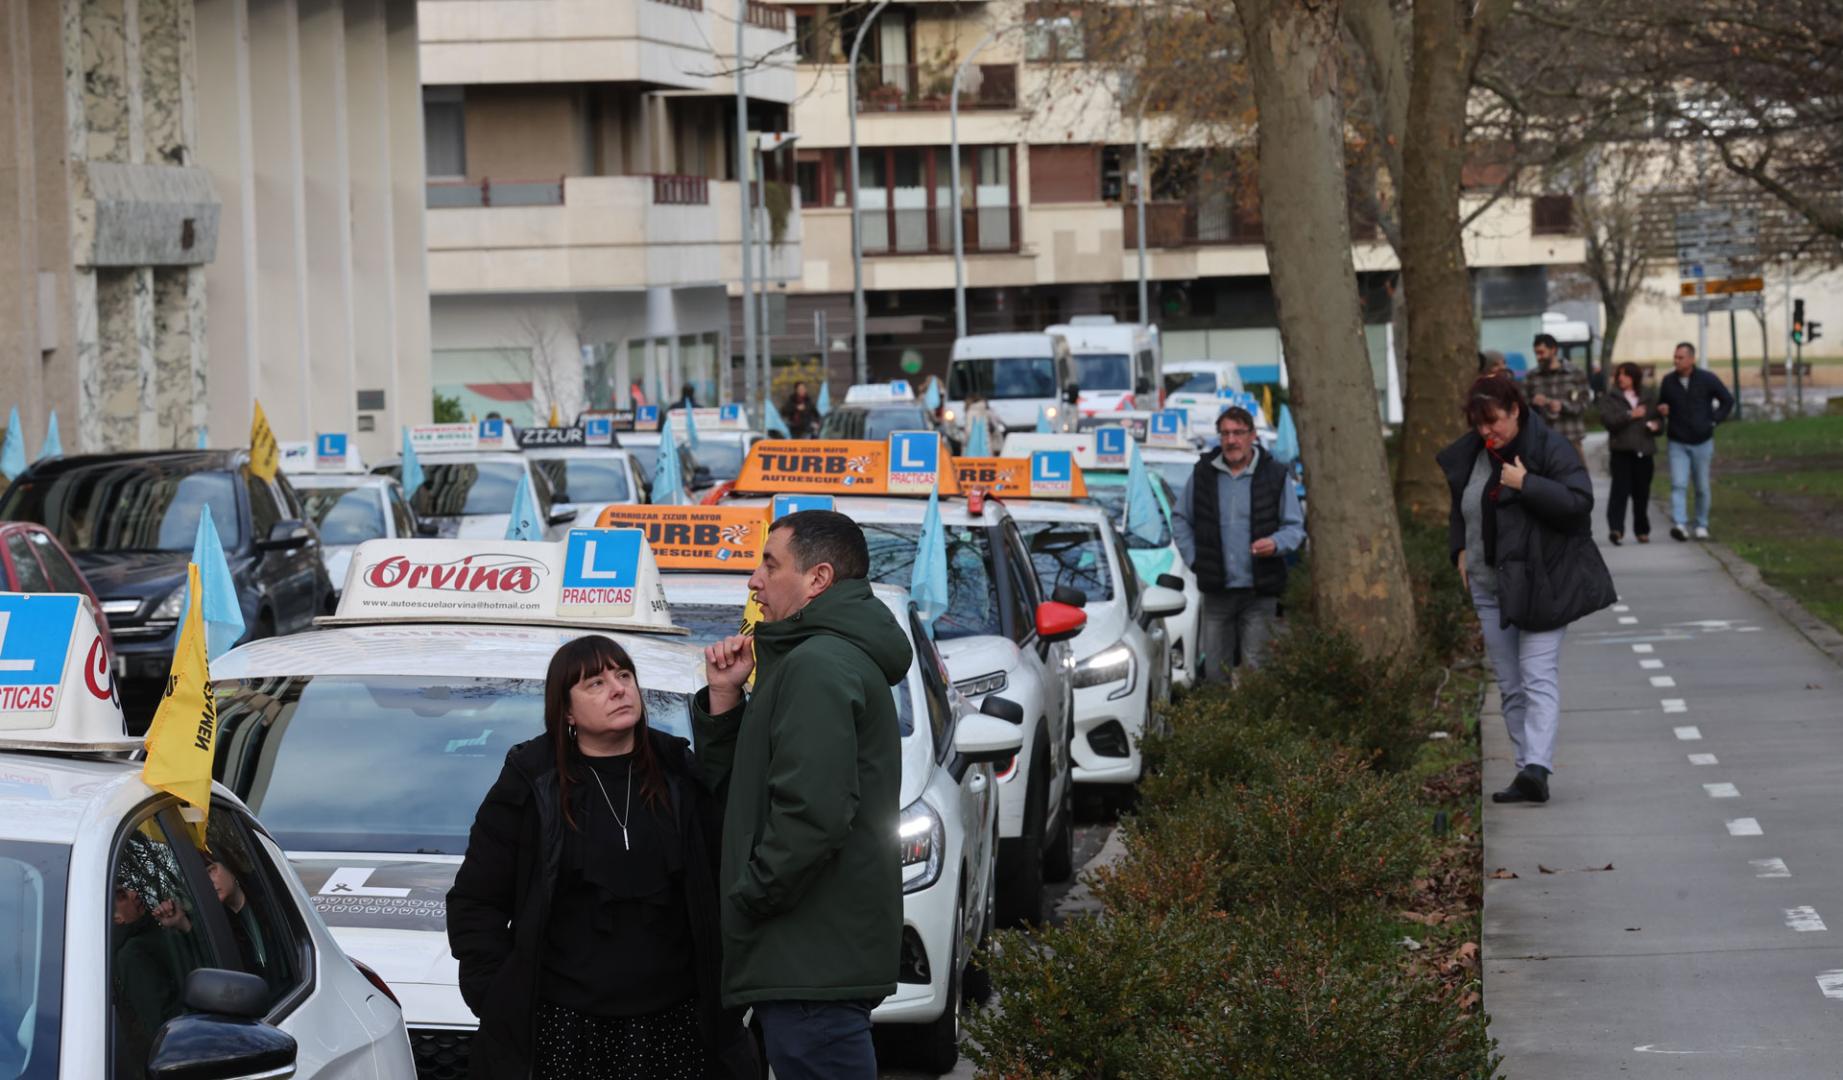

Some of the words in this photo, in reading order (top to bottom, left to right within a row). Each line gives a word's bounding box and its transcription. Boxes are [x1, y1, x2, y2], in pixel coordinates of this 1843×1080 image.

[641, 407, 652, 420] L
[483, 421, 497, 436] L
[592, 421, 605, 434] L
[1157, 416, 1172, 431] L
[522, 429, 583, 444] ZIZUR
[1103, 432, 1119, 451] L
[324, 437, 340, 453] L
[901, 439, 925, 467] L
[1041, 456, 1061, 478] L
[890, 472, 936, 484] PRACTICAS
[662, 513, 687, 521] ZIZUR
[690, 513, 722, 521] MAYOR
[581, 540, 617, 579] L
[370, 555, 533, 592] Orvina
[562, 588, 632, 604] PRACTICAS
[362, 599, 540, 610] www.autoescuelaorvina@hotmail.com
[0, 686, 54, 709] TICAS
[317, 867, 412, 897] L
